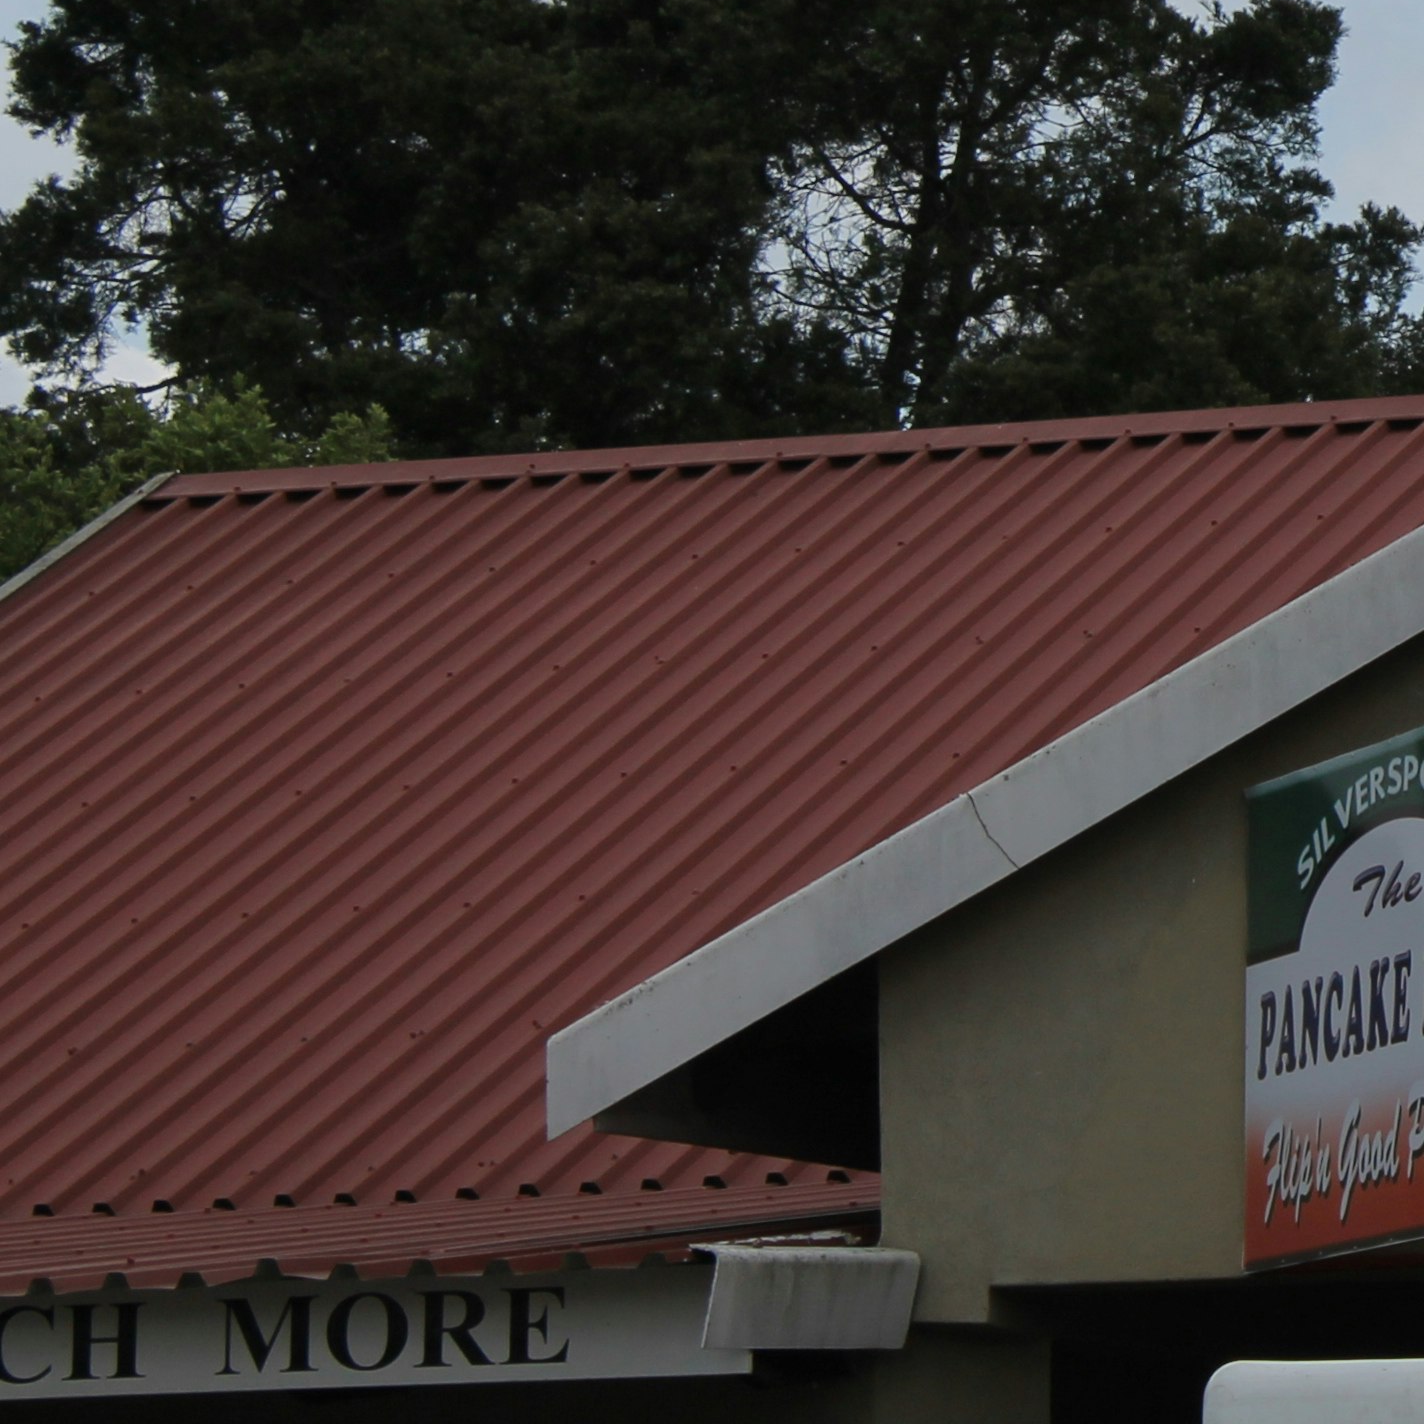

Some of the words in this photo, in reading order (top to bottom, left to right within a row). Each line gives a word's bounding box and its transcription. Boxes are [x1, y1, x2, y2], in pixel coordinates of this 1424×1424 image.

[1353, 860, 1423, 917] The
[1257, 949, 1411, 1080] PANCAKE
[1338, 1097, 1401, 1222] Good
[0, 1301, 147, 1384] CH
[214, 1285, 570, 1375] MORE
